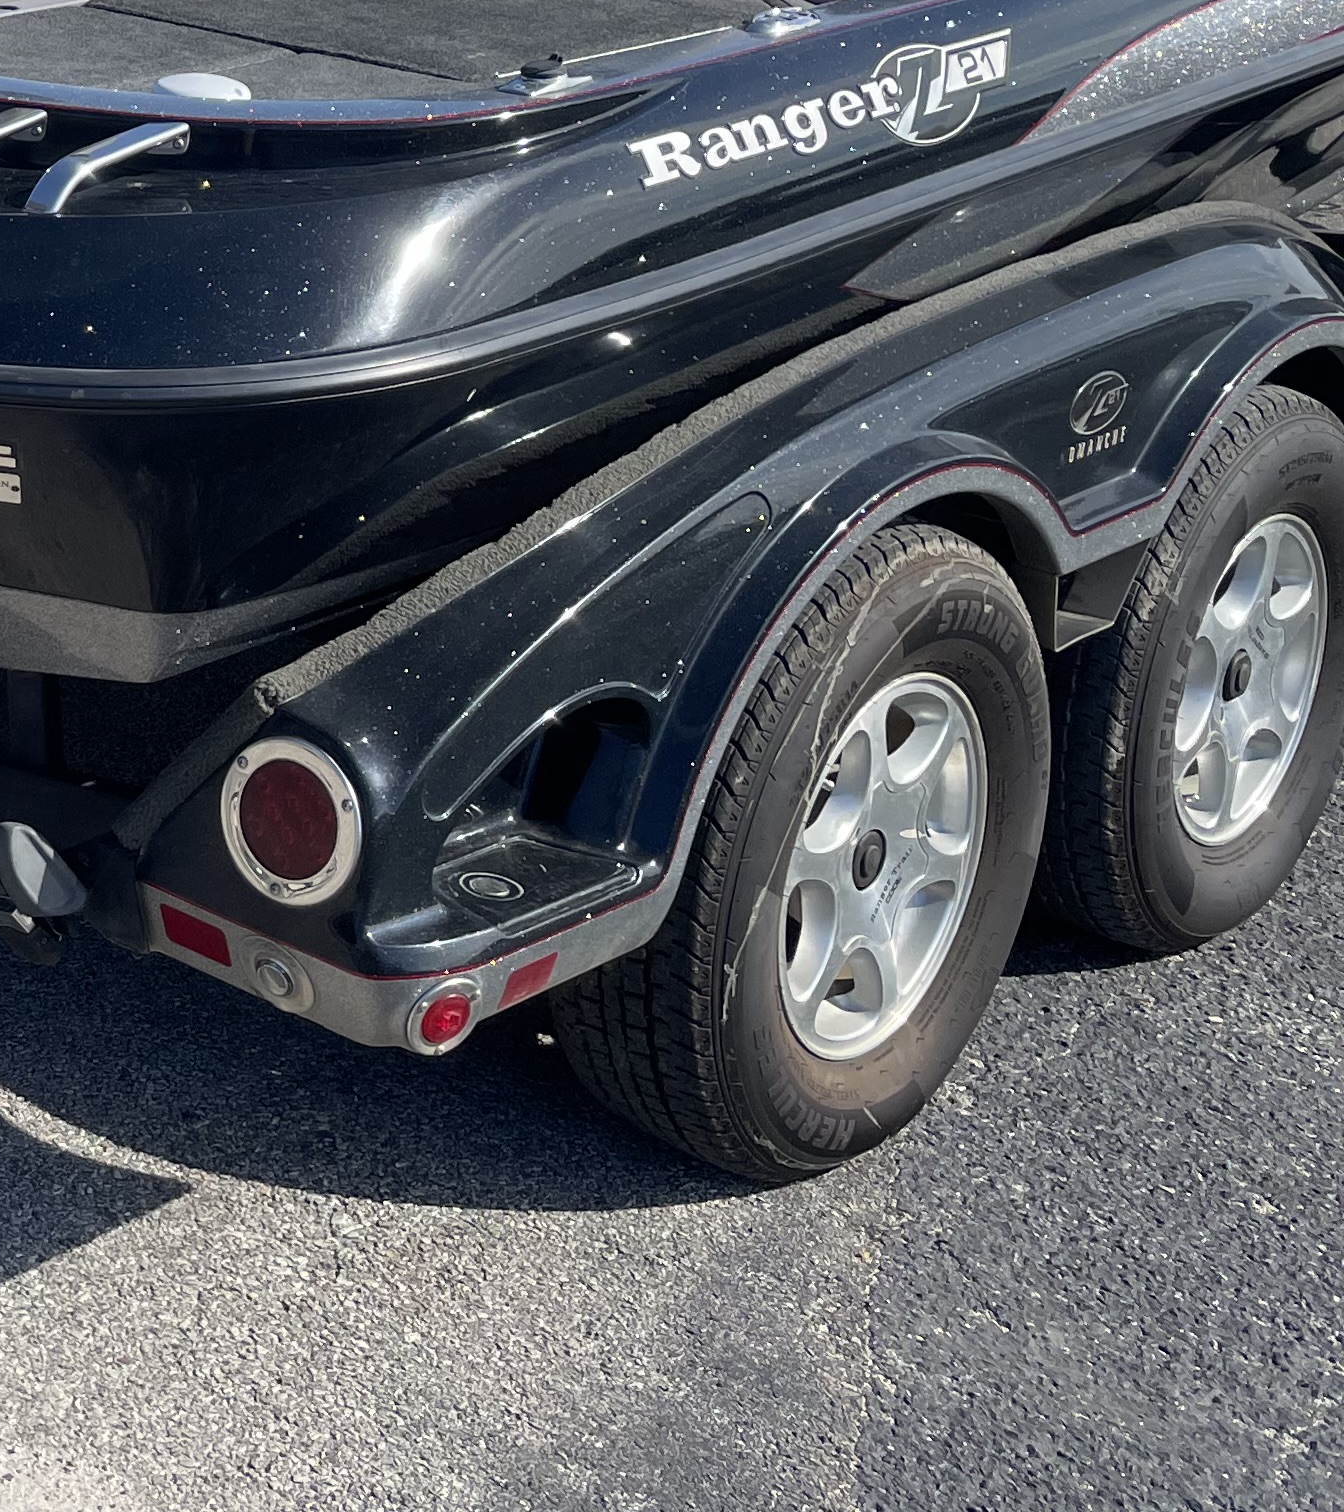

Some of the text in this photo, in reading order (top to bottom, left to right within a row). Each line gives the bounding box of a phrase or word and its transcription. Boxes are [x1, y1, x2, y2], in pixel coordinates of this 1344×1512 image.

[625, 74, 903, 190] Ranger
[1059, 425, 1127, 467] OMANCHE
[936, 599, 1019, 656] STRONG
